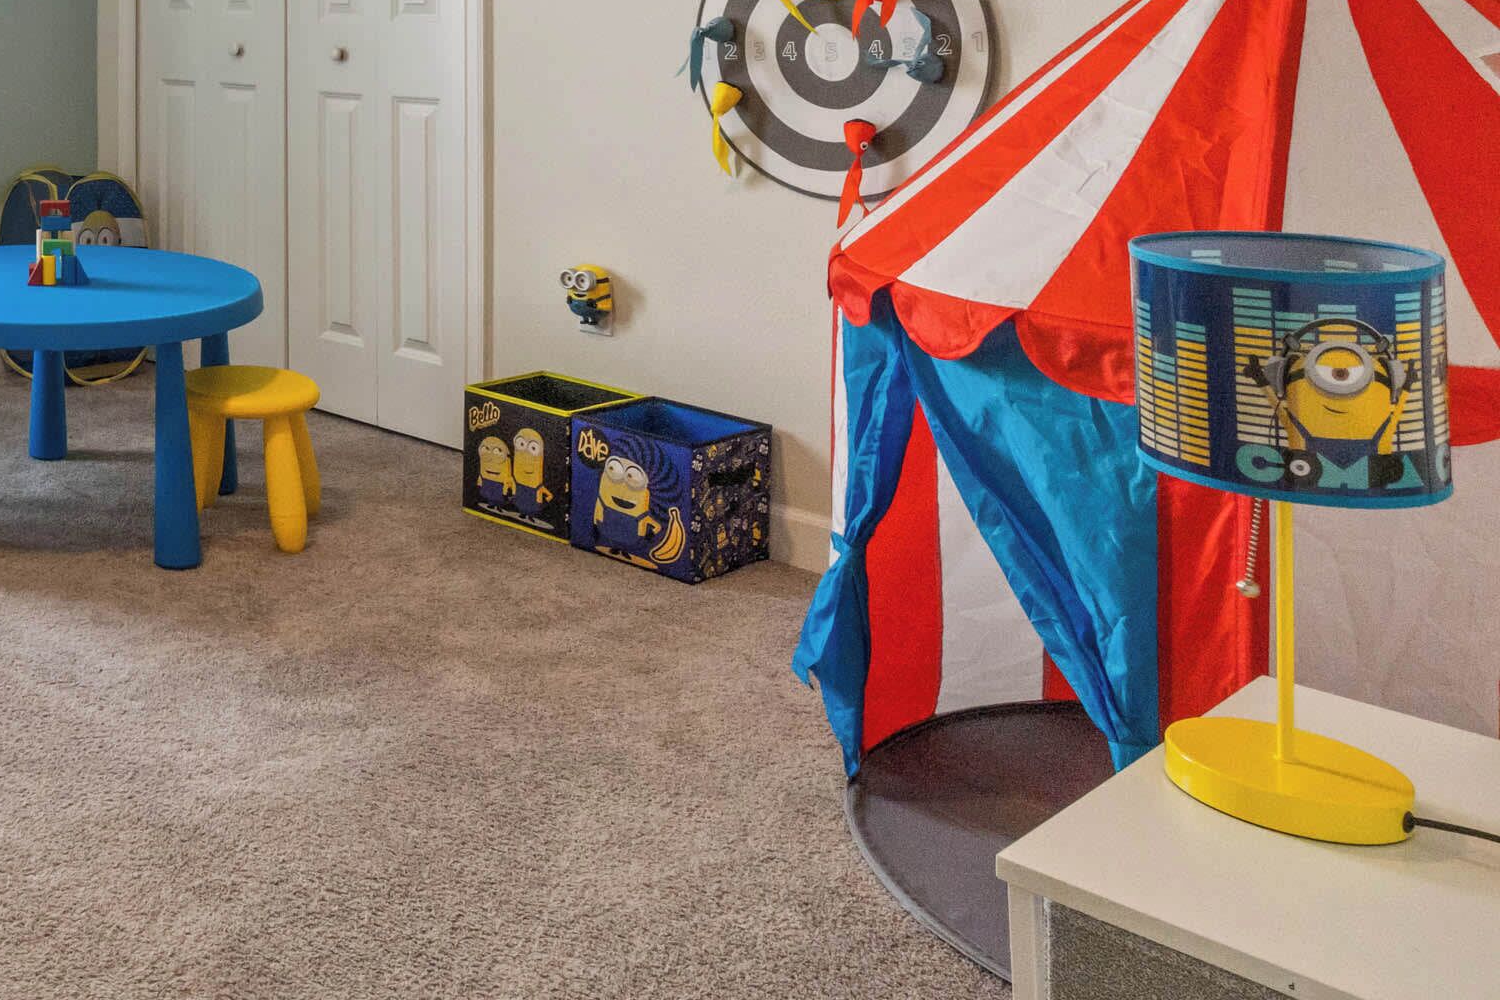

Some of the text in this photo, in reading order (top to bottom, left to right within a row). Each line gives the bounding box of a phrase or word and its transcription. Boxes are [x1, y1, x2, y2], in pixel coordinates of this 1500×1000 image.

[724, 42, 738, 60] 2
[753, 42, 766, 61] 3
[783, 42, 797, 61] 4
[824, 42, 837, 62] 5
[869, 40, 883, 59] 4
[936, 34, 952, 55] 2
[972, 32, 984, 52] 1
[471, 404, 498, 425] Bello
[578, 429, 608, 461] Dave
